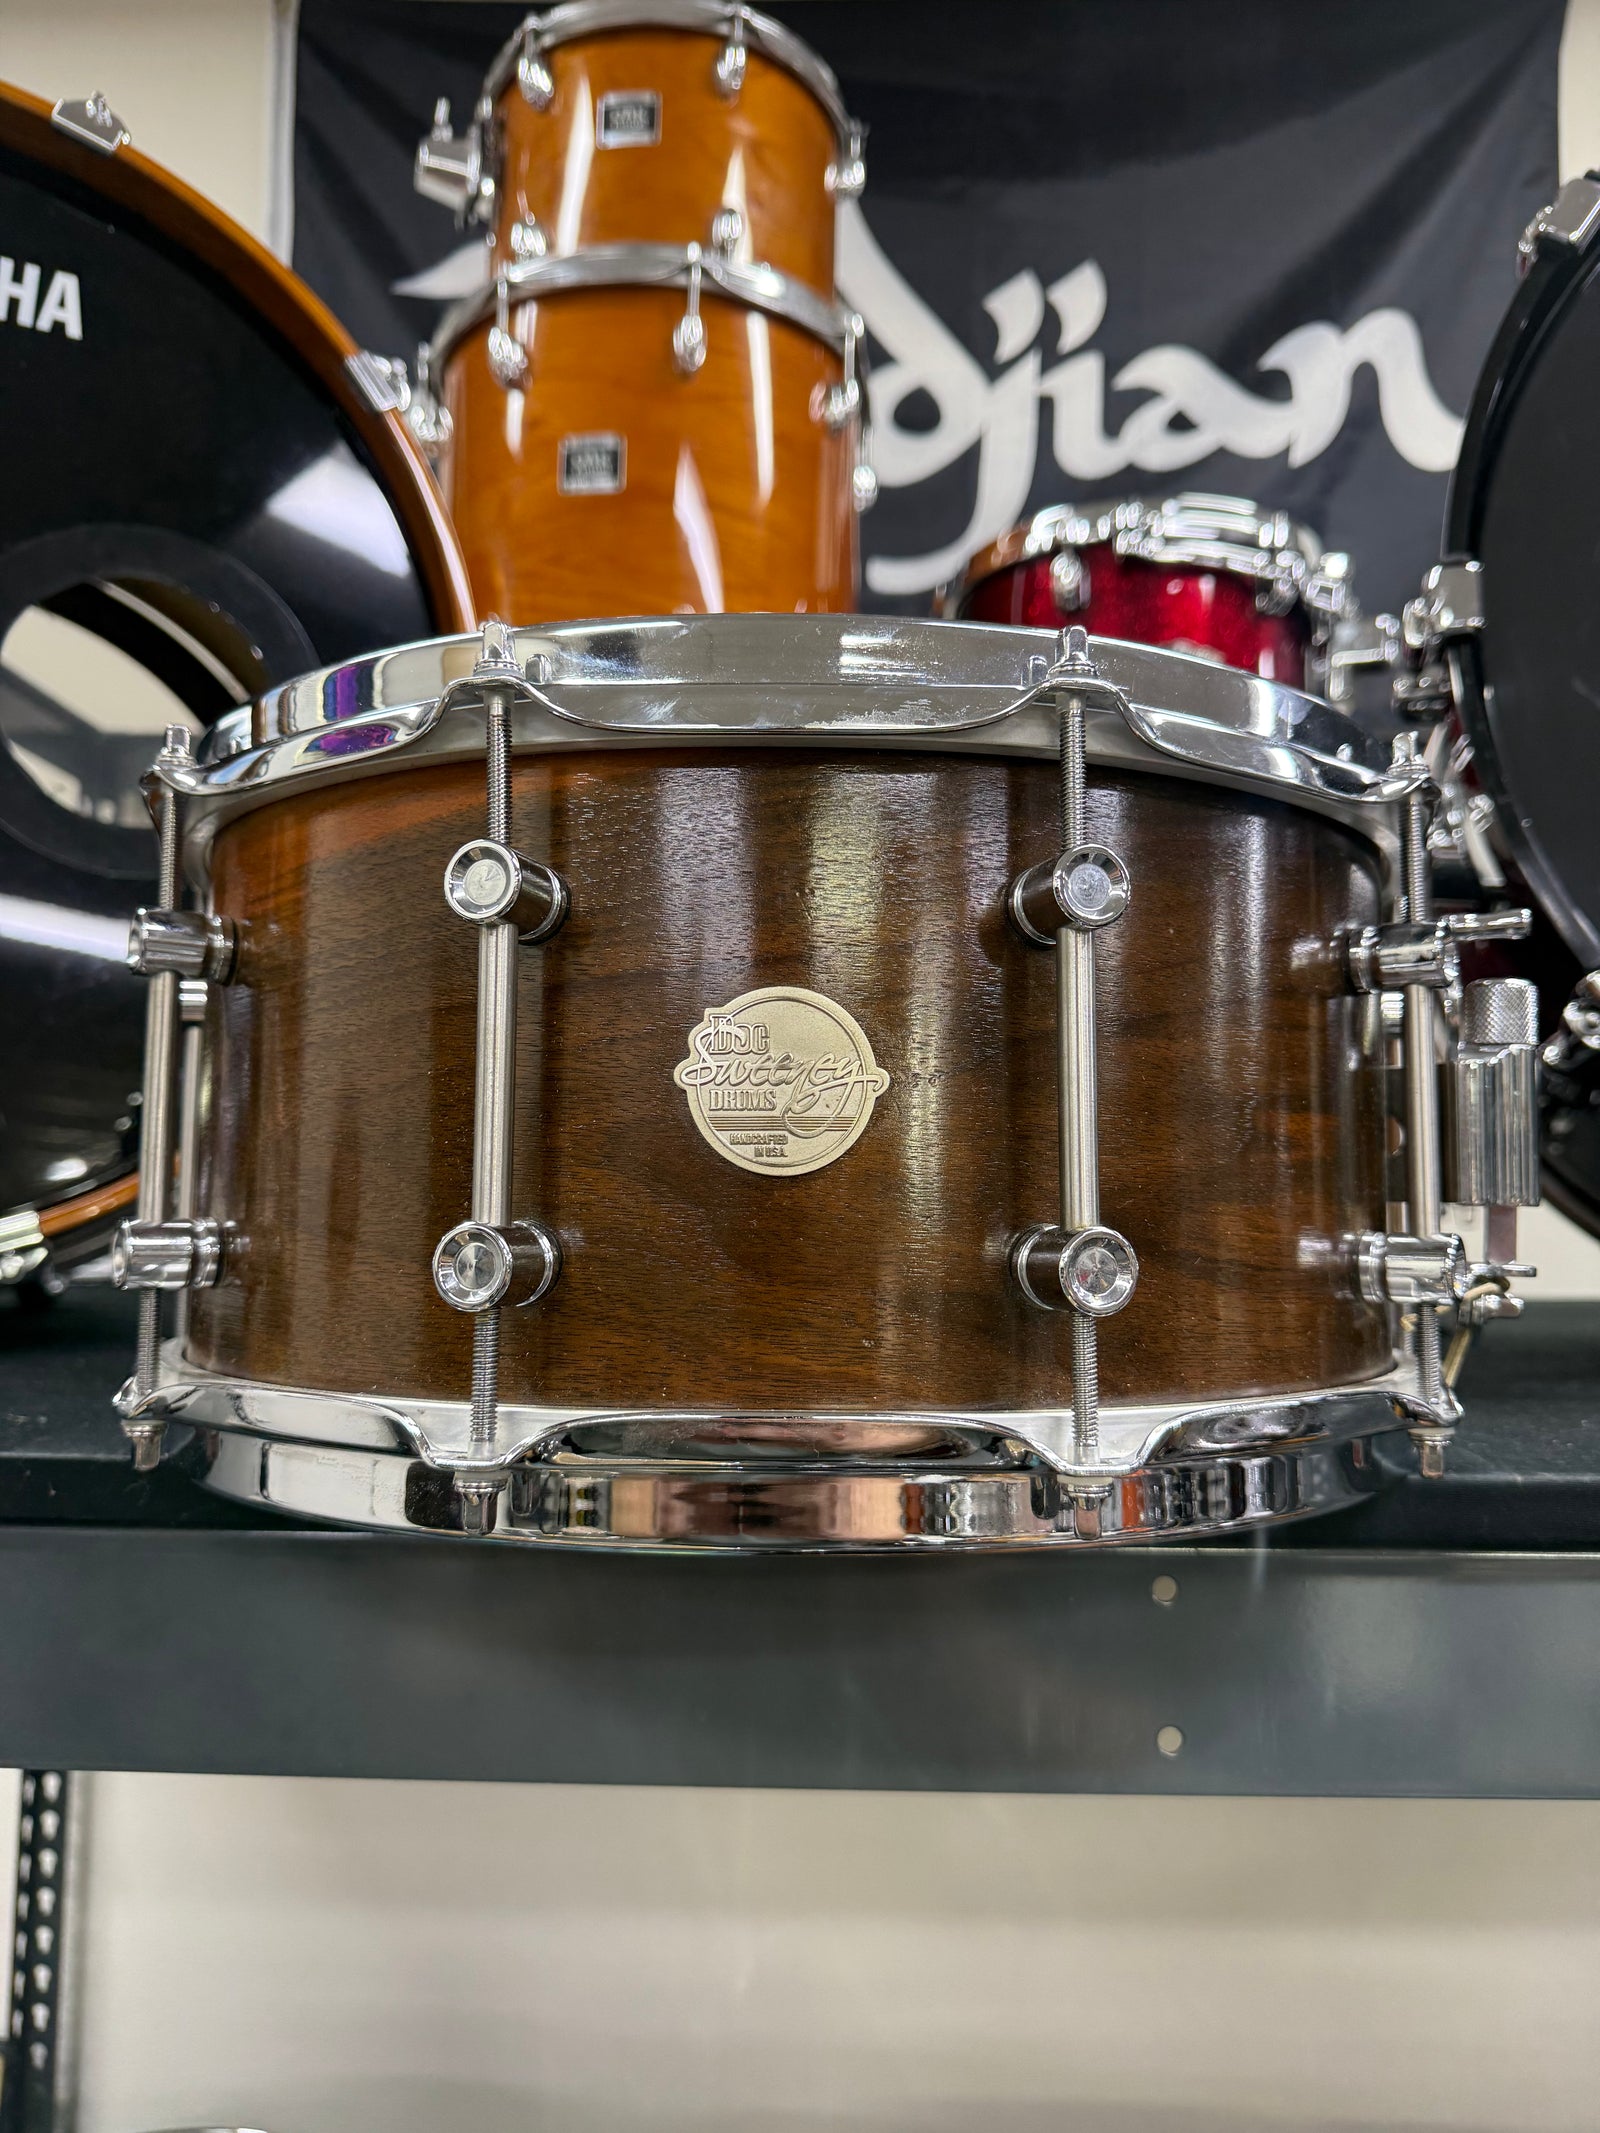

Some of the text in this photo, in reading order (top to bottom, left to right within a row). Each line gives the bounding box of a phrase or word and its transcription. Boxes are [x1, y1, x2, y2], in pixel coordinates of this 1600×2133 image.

[0, 254, 84, 341] HA
[834, 193, 1464, 595] djian
[680, 1021, 884, 1139] Sweeney
[708, 1088, 778, 1112] DRUMS
[729, 1132, 789, 1146] HANDCRAFTED
[753, 1145, 765, 1158] IN
